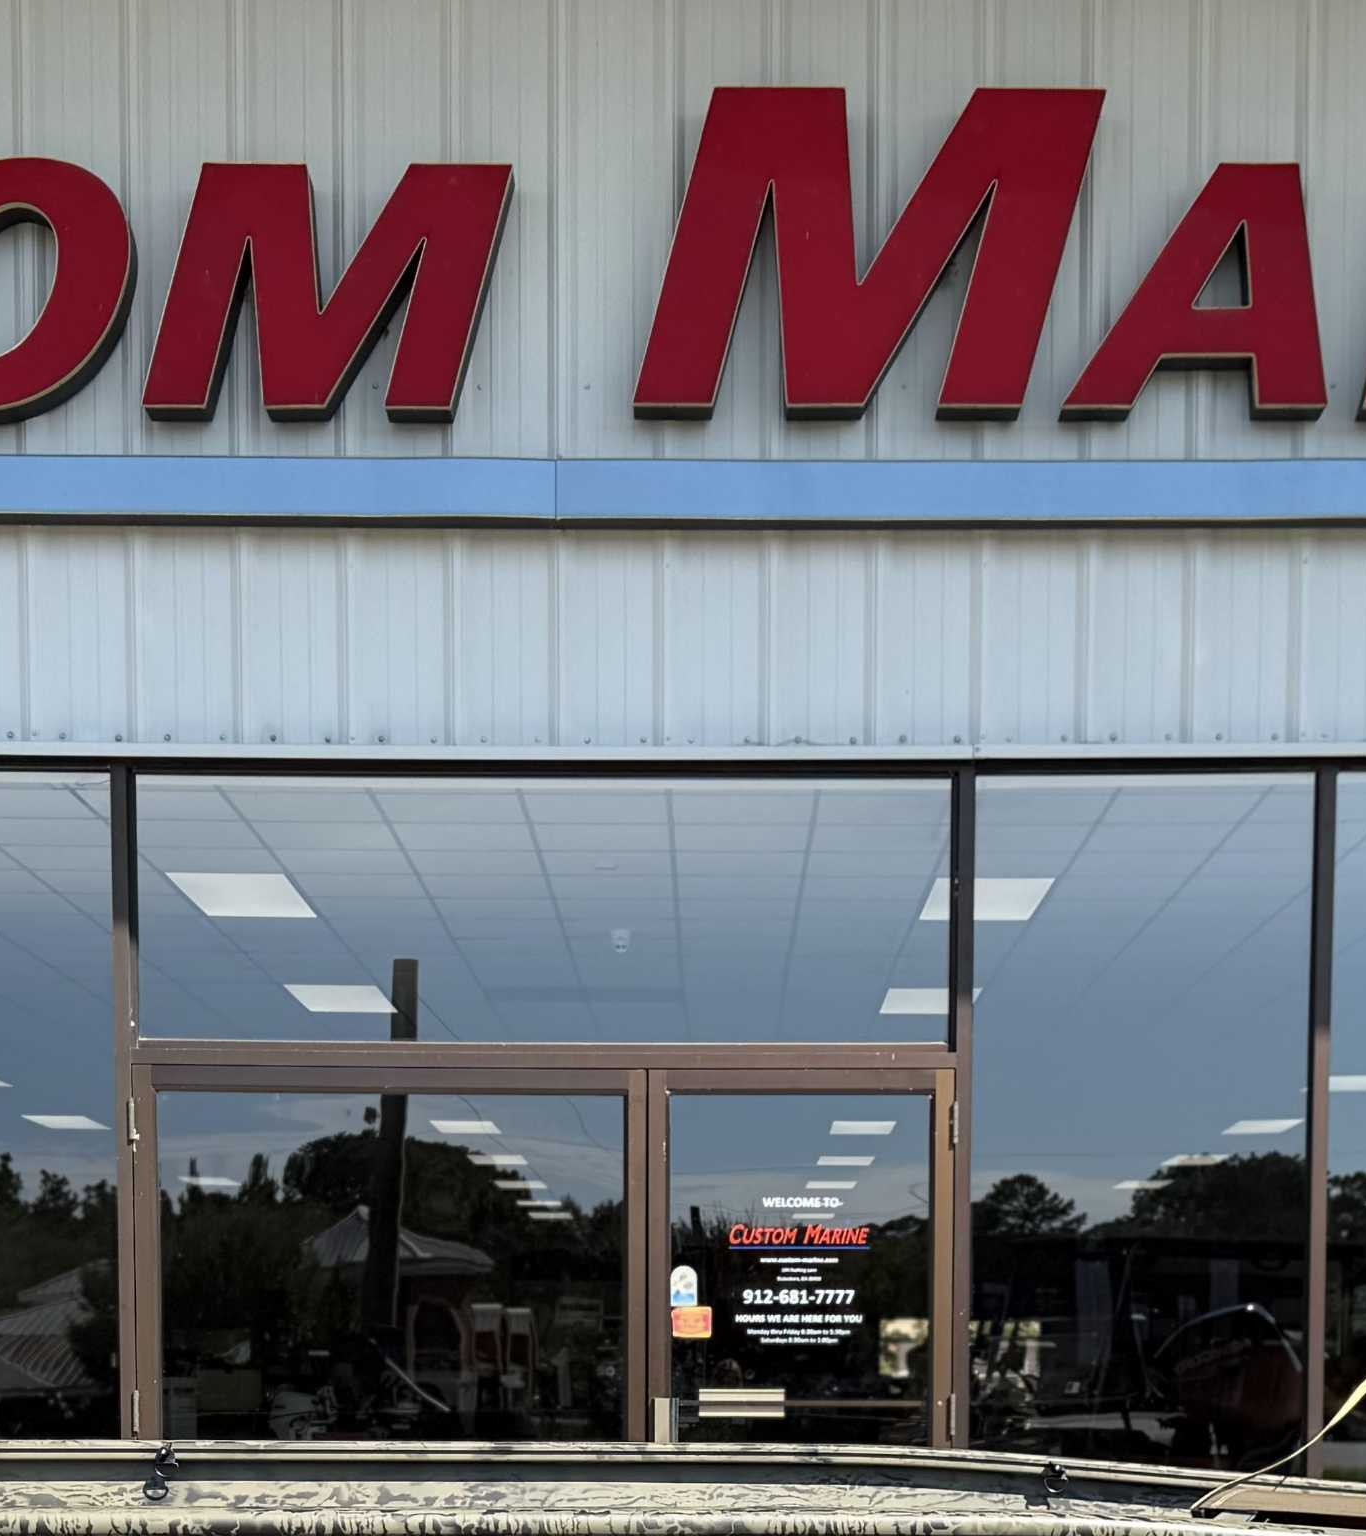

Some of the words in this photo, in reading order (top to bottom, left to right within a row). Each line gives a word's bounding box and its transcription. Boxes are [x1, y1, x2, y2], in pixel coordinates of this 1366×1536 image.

[762, 1196, 821, 1208] WELCOME
[729, 1223, 798, 1244] CUSTOM
[802, 1223, 870, 1244] MARINE
[742, 1289, 855, 1305] 912-681-7777
[735, 1314, 765, 1323] HOURS
[767, 1314, 781, 1323] WE
[783, 1314, 800, 1323] ARE
[801, 1314, 823, 1323] HERE
[825, 1314, 842, 1323] FOR
[843, 1314, 863, 1323] YOU
